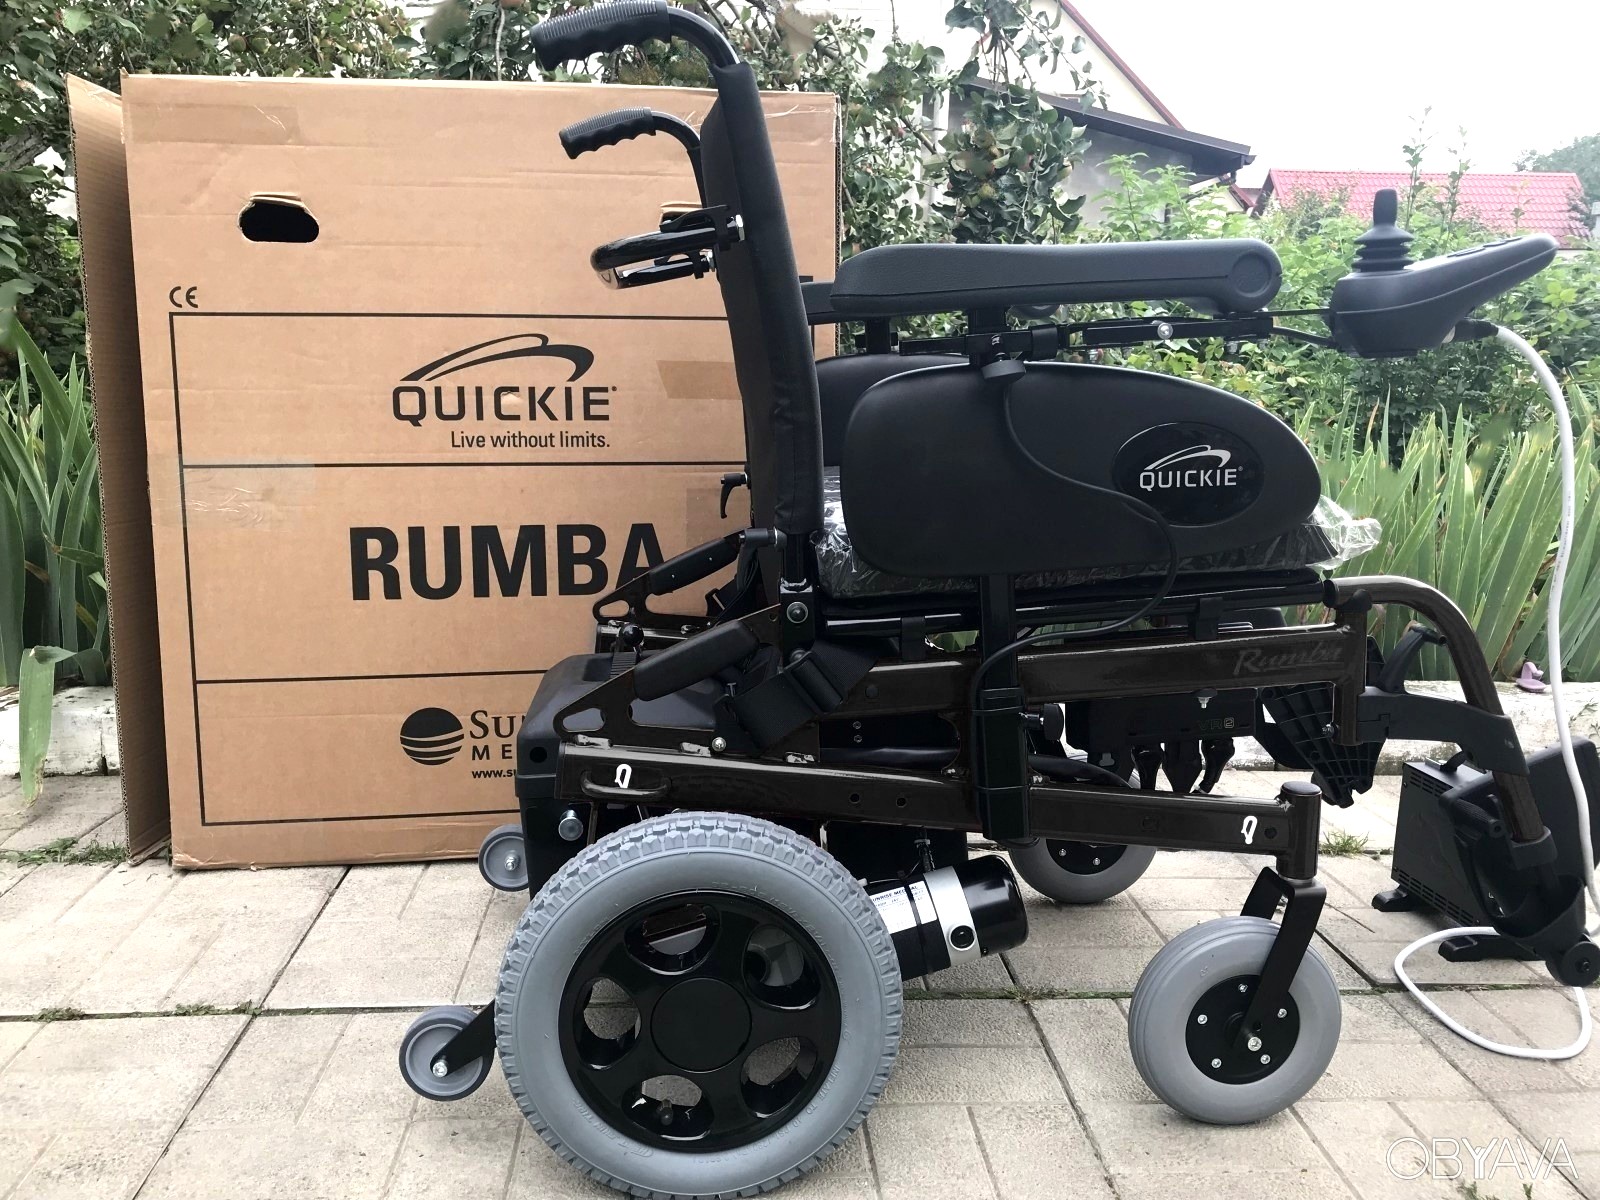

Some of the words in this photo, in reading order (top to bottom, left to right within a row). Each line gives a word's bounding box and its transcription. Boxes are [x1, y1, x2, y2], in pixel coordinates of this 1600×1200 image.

[169, 285, 199, 309] CE
[392, 384, 611, 427] QUICKIE
[451, 430, 486, 448] Live
[490, 430, 556, 448] without
[559, 430, 611, 448] limits.
[1139, 468, 1238, 492] QUICKIE
[349, 523, 667, 601] RUMBA
